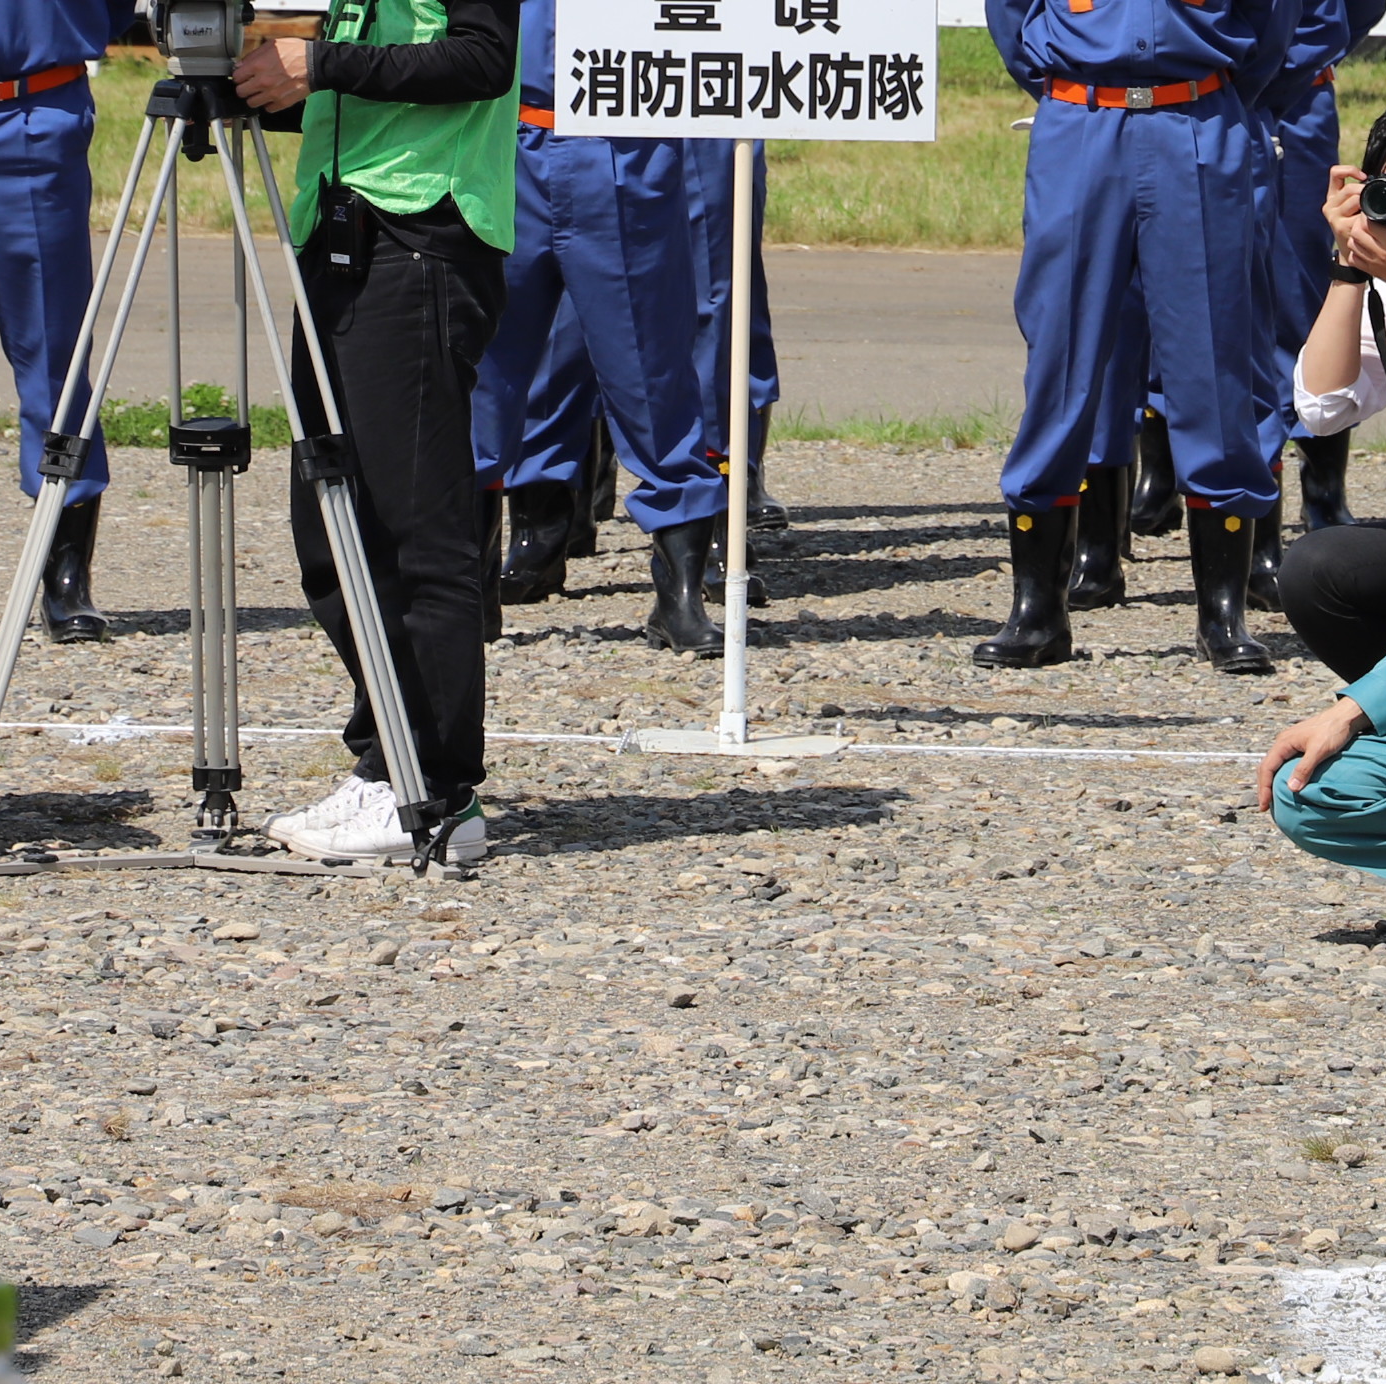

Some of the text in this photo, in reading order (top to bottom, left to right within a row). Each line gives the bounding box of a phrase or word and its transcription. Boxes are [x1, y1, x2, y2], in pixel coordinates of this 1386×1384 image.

[569, 48, 924, 121] 消防団水防隊
